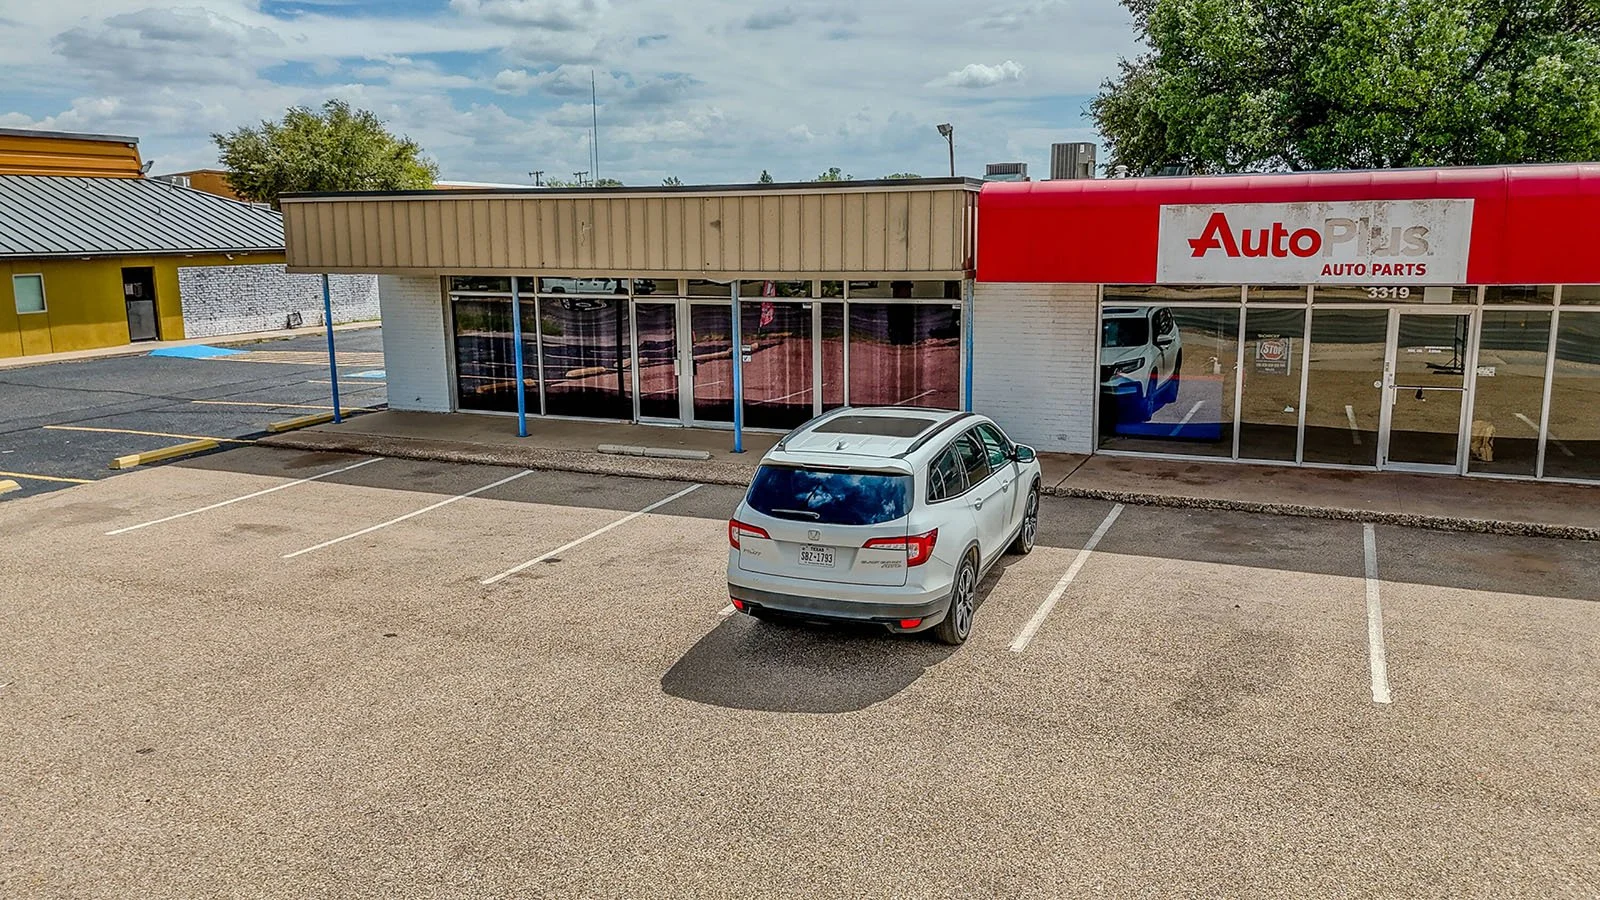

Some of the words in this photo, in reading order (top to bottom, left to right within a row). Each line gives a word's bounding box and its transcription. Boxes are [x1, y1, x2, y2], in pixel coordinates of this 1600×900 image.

[1321, 263, 1366, 276] AUTO
[1371, 263, 1427, 276] PARTS
[1367, 286, 1410, 299] 3319
